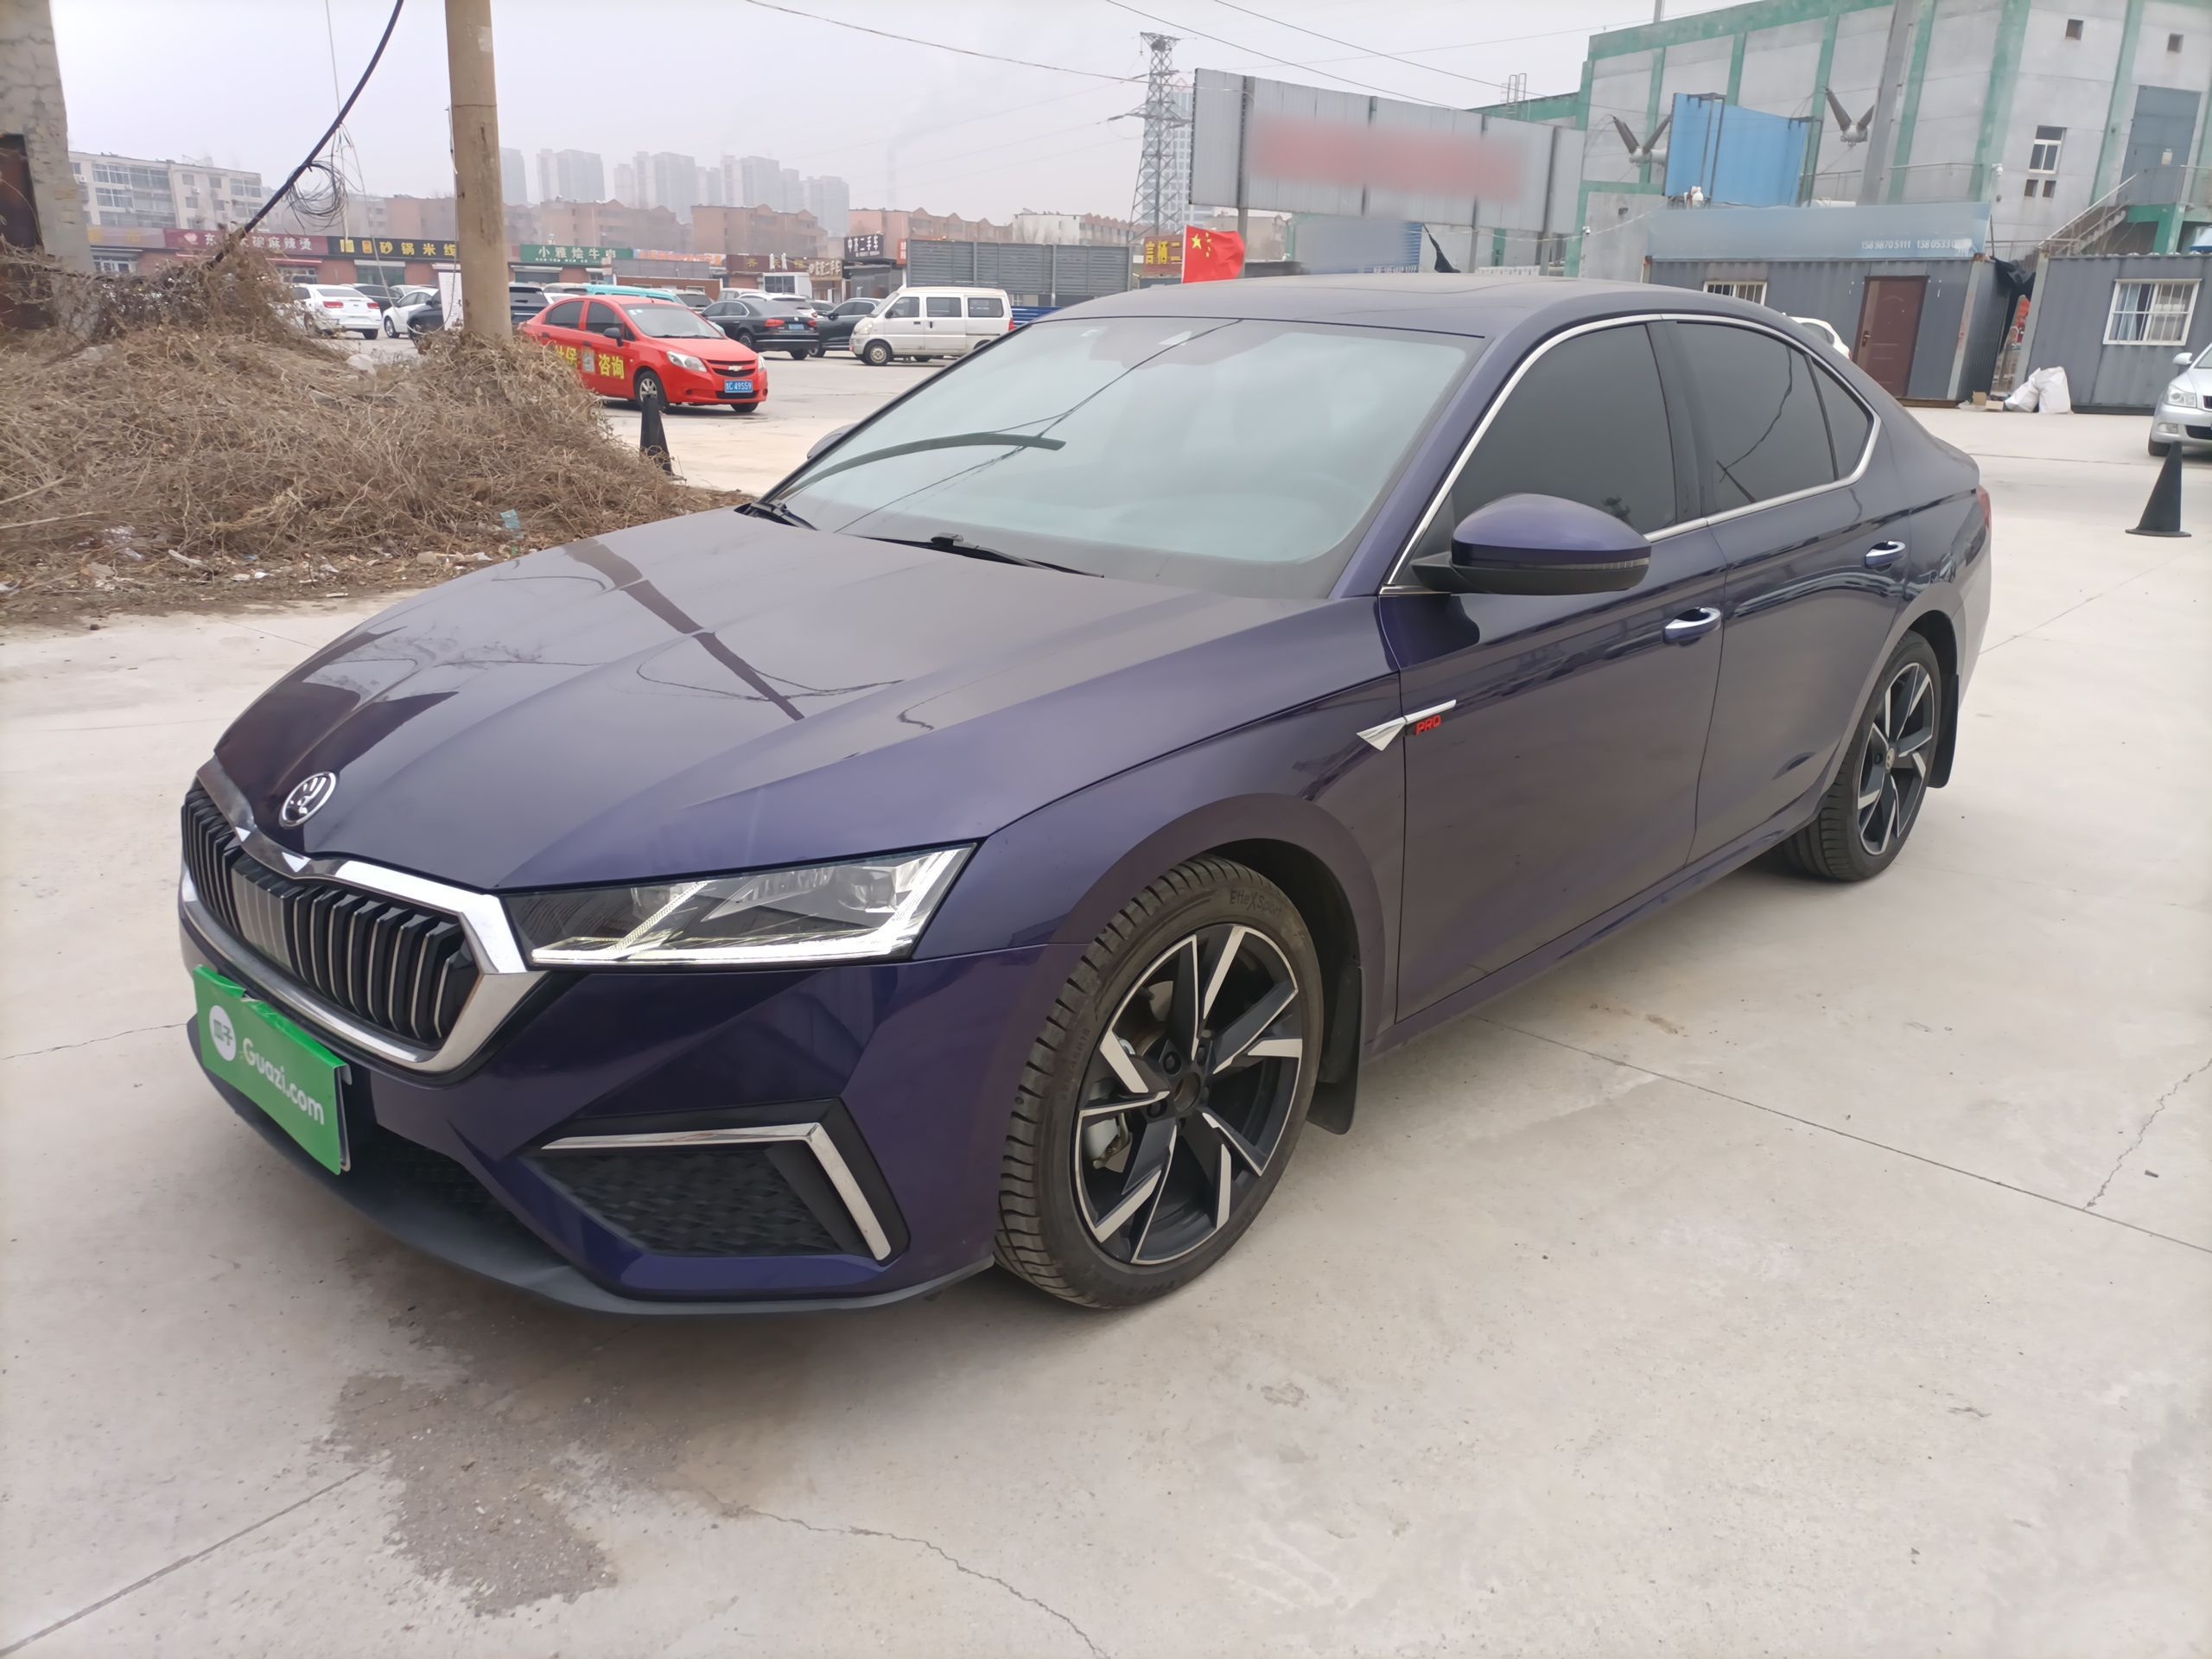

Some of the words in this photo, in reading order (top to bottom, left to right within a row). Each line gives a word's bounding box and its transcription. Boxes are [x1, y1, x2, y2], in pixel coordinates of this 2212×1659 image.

[598, 353, 625, 380] 咨询
[1414, 715, 1442, 735] PRO
[243, 1038, 325, 1126] Guazi.com
